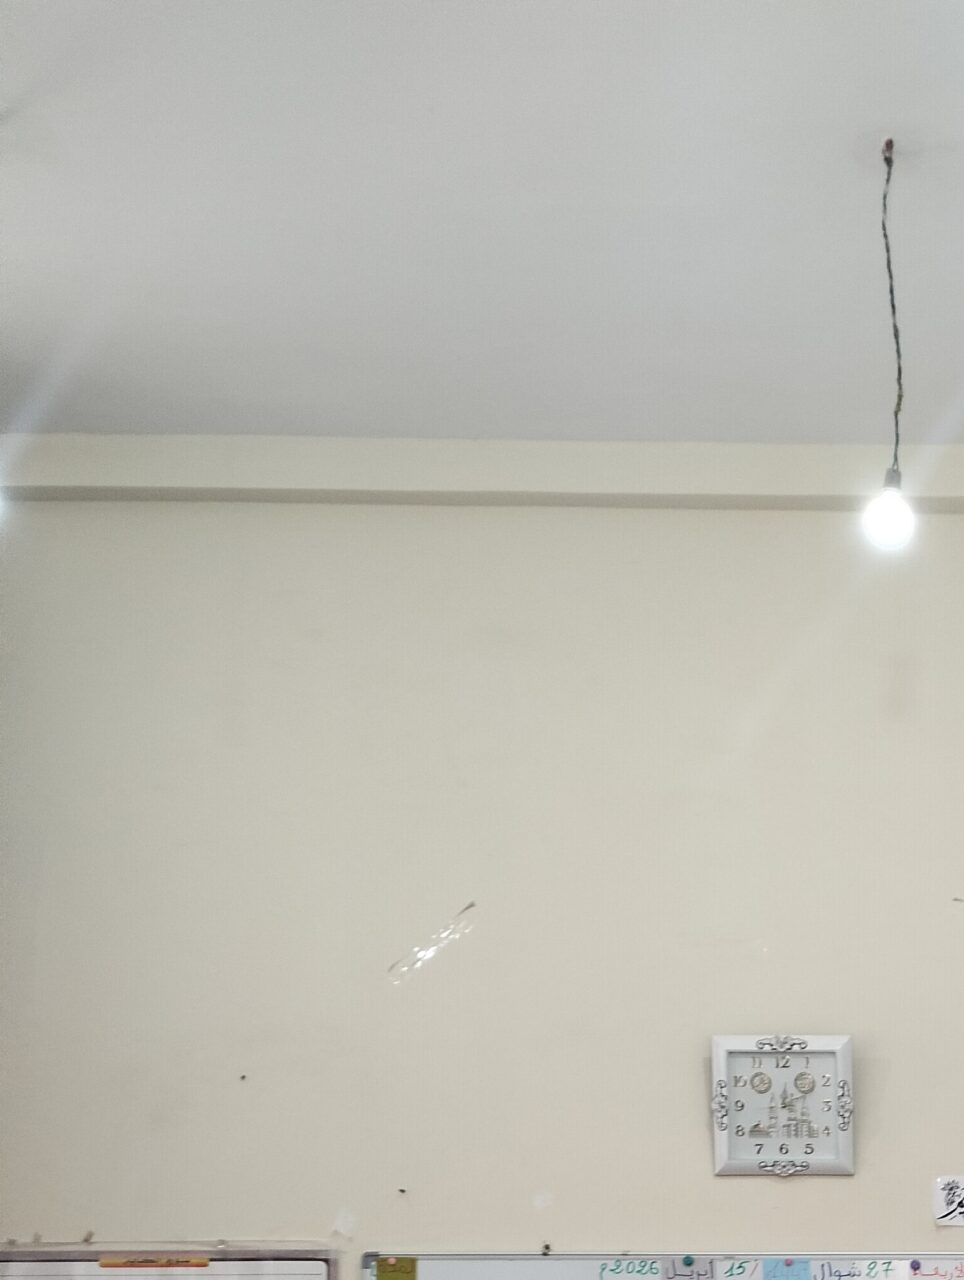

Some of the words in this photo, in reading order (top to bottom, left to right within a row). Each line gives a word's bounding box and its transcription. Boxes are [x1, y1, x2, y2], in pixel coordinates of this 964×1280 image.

[775, 1055, 791, 1069] 12
[732, 1075, 748, 1088] 10
[822, 1074, 832, 1087] 2
[734, 1100, 745, 1112] 9
[822, 1100, 832, 1112] 3
[735, 1124, 746, 1137] 8
[822, 1126, 832, 1137] 4
[754, 1143, 765, 1155] 7
[778, 1143, 789, 1155] 6
[803, 1143, 815, 1155] 5
[724, 1260, 750, 1278] 15
[866, 1261, 896, 1279] 27
